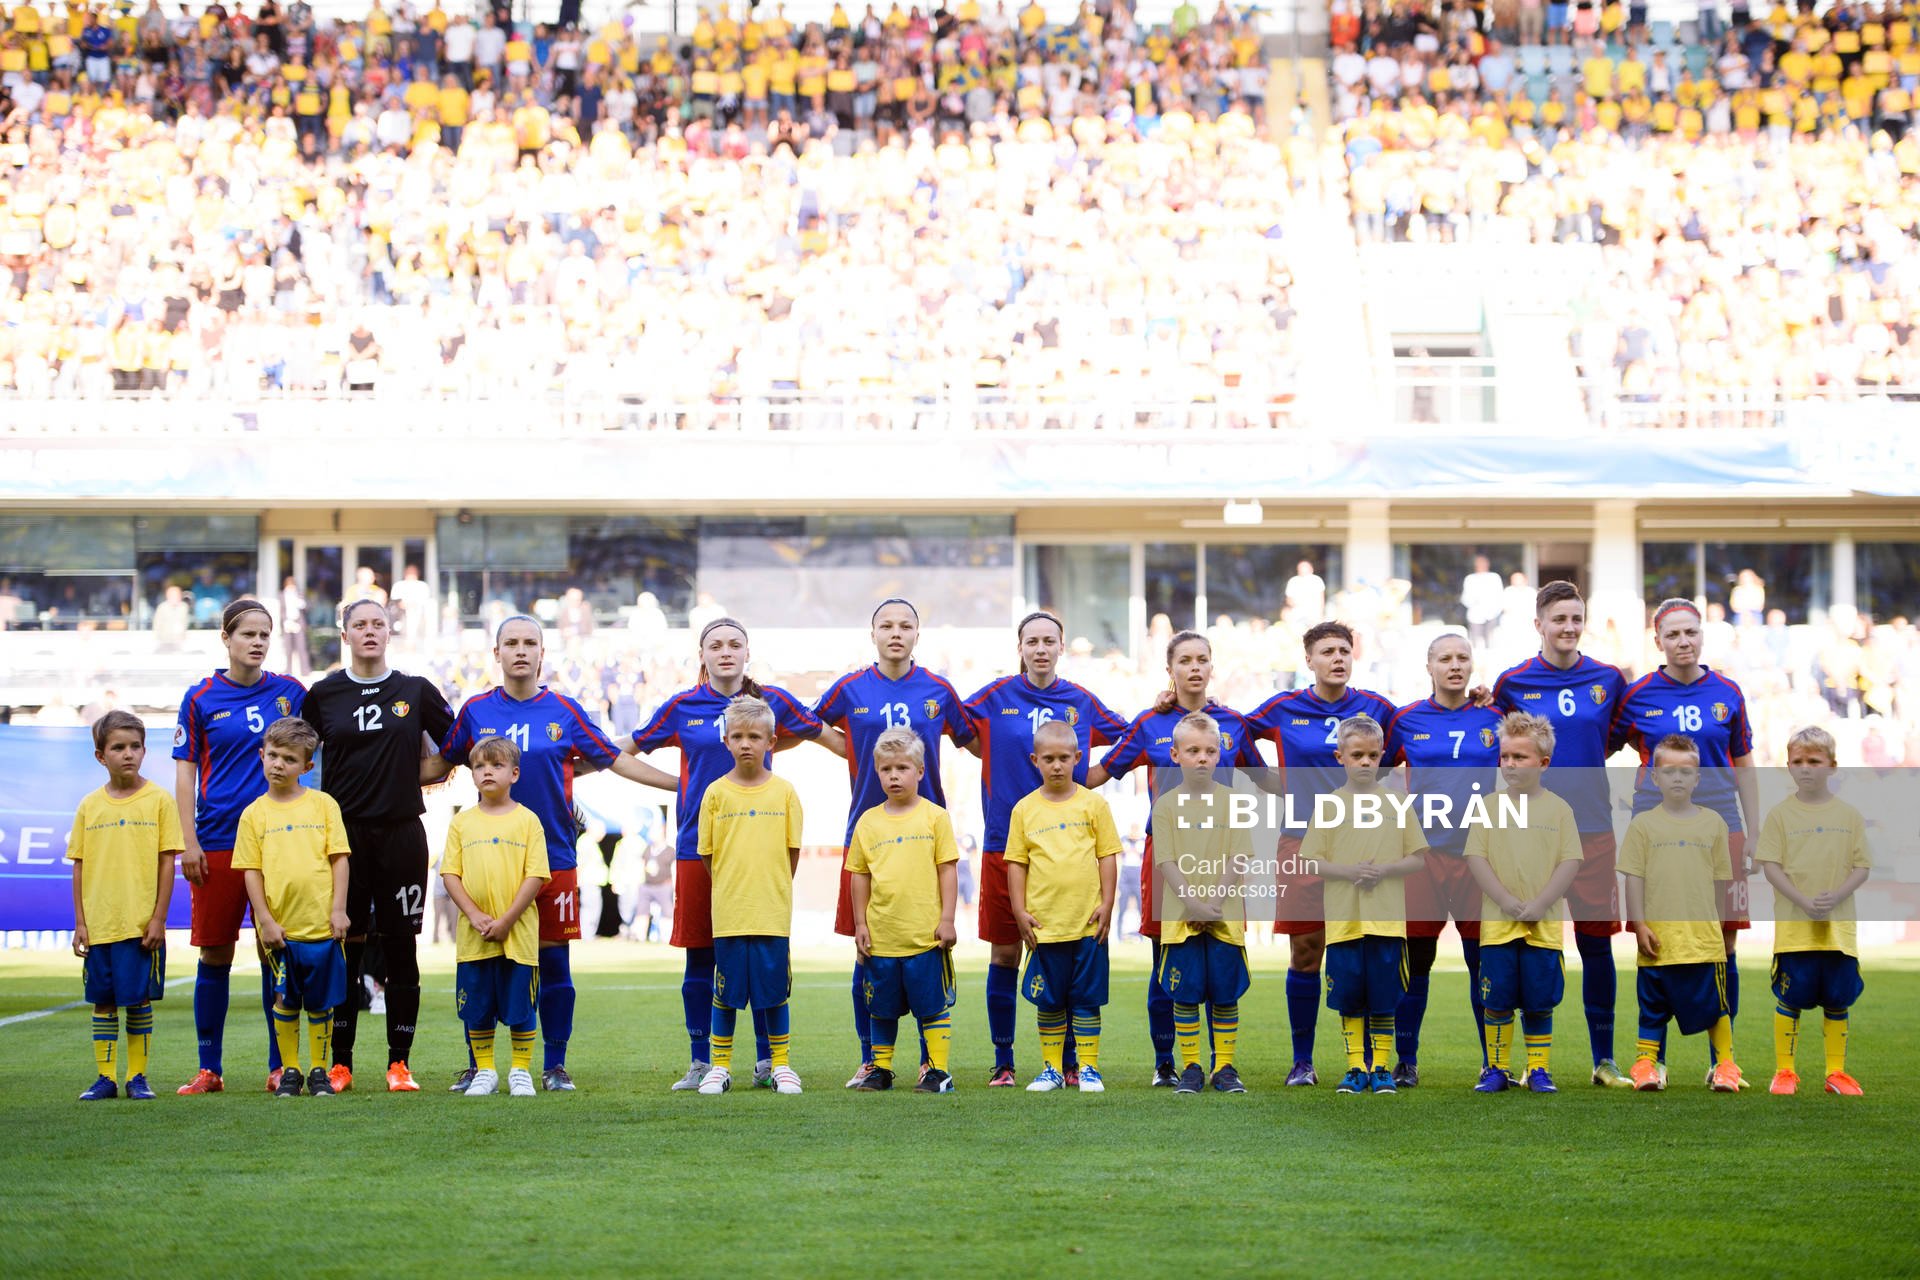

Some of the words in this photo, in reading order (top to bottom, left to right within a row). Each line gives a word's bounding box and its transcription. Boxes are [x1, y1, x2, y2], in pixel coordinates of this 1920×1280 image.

[361, 687, 380, 696] JAKO
[1557, 688, 1577, 717] 6
[213, 711, 231, 721] JAKO
[246, 706, 264, 734] 5
[353, 704, 383, 732] 12
[687, 719, 704, 727] JAKO
[853, 706, 869, 715] JAKO
[879, 702, 911, 730] 13
[1645, 709, 1663, 718] JAKO
[1672, 705, 1703, 732] 18
[479, 727, 497, 736] JAKO
[505, 723, 530, 752] 11
[1155, 736, 1172, 745] JAKO
[1413, 733, 1431, 741] JAKO
[1448, 730, 1466, 759] 7
[395, 883, 424, 916] 12
[554, 890, 574, 922] 11
[1727, 880, 1748, 912] 18
[395, 1024, 415, 1033] JAKO
